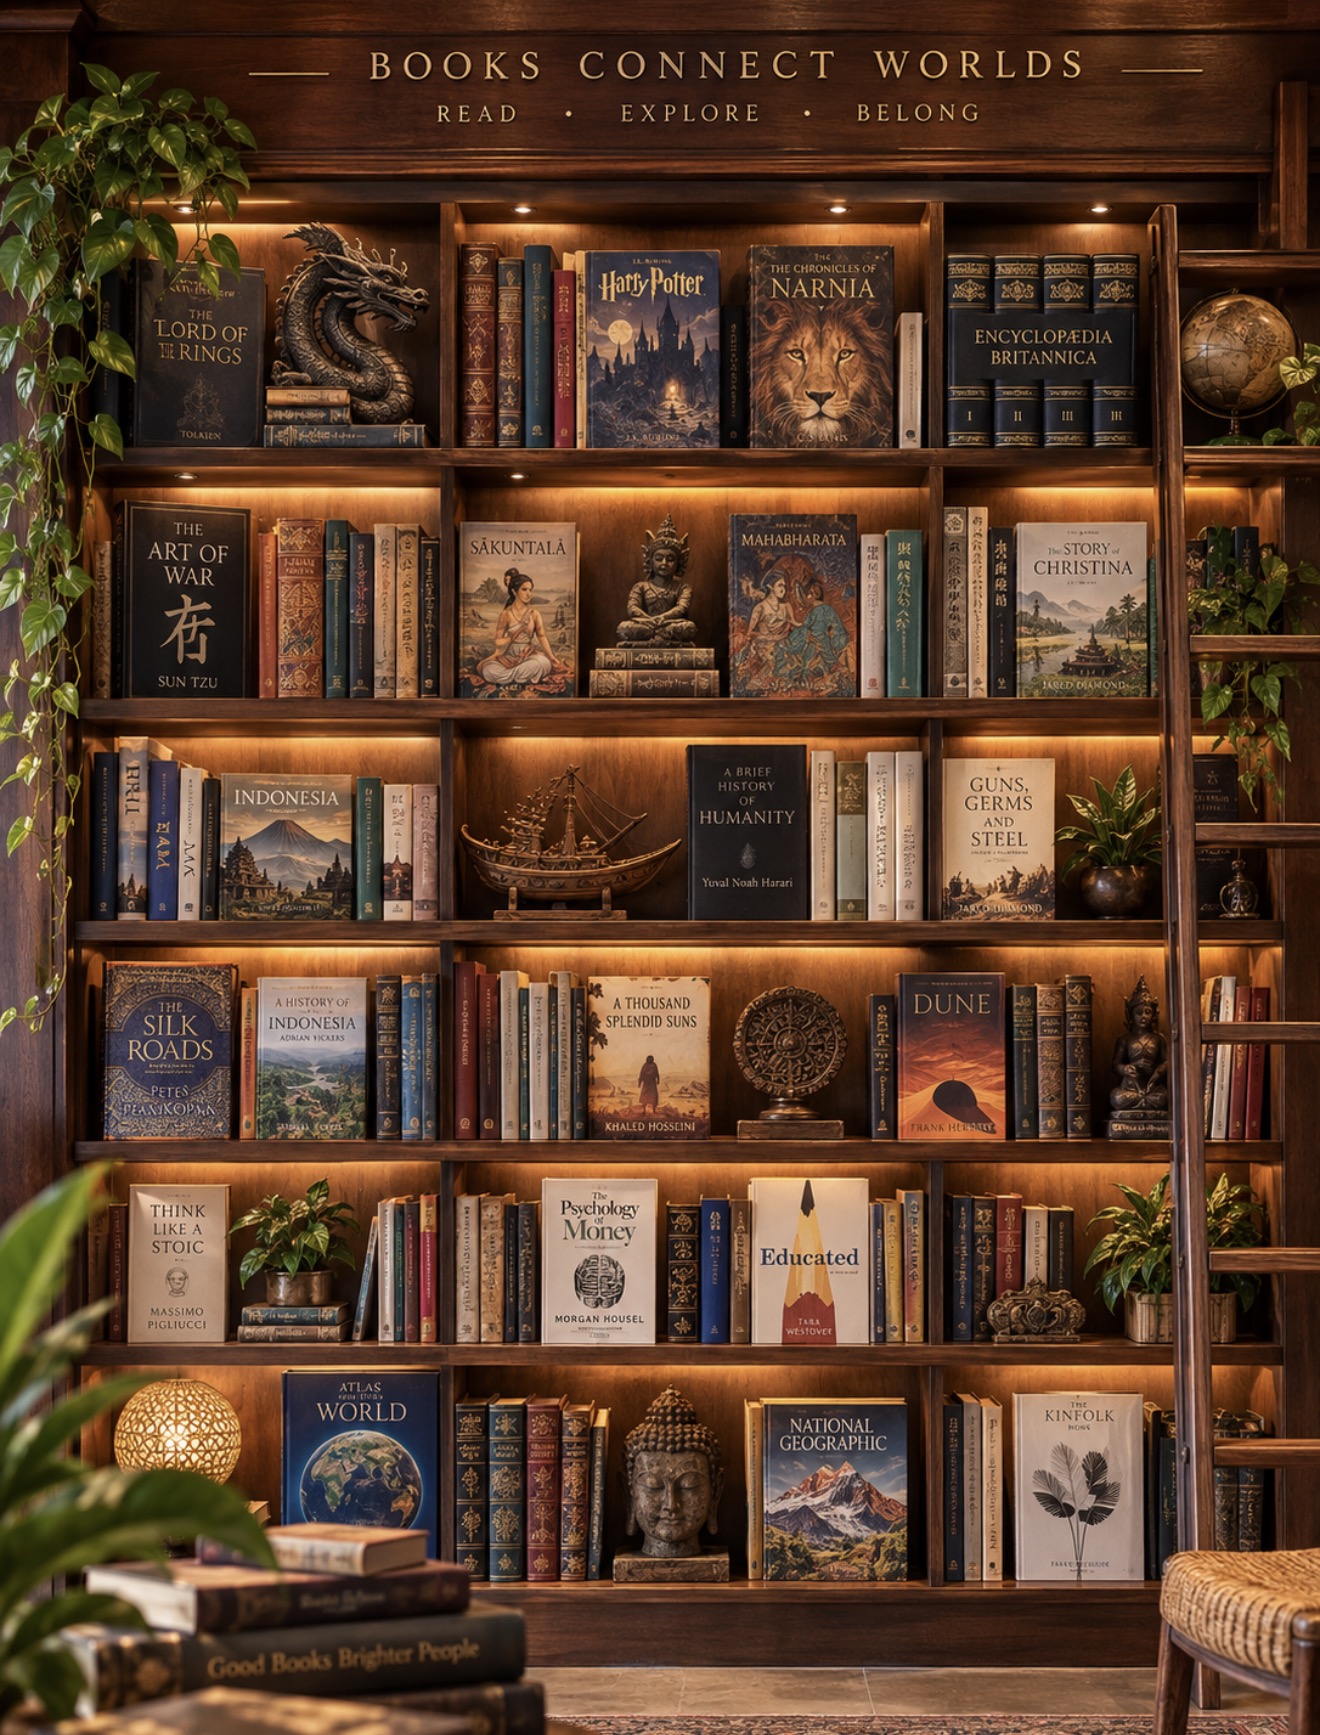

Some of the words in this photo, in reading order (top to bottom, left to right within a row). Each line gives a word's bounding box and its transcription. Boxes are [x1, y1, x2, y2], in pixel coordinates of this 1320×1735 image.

[369, 50, 542, 81] BOOKS
[579, 49, 836, 81] CONNECT
[873, 49, 1084, 81] WORLDS
[436, 103, 518, 123] READ
[620, 103, 760, 123] EXPLORE
[857, 103, 981, 123] BELONG
[771, 264, 791, 273] THE
[793, 264, 860, 273] CHRONICLES
[862, 264, 877, 273] OF
[597, 269, 650, 303] Harry
[650, 266, 705, 307] Potter
[769, 277, 876, 299] NARNIA
[188, 308, 213, 321] THE
[153, 318, 217, 342] LORD
[221, 325, 249, 344] OF
[974, 328, 1114, 345] ENCYCLOPÆDIA
[178, 343, 243, 365] RINGS
[990, 350, 1098, 366] BRITANNICA
[1061, 410, 1074, 422] III
[173, 521, 204, 537] THE
[741, 533, 847, 547] MAHABHARATA
[147, 541, 193, 562] ART
[198, 543, 230, 565] OF
[1063, 542, 1111, 556] STORY
[1033, 559, 1133, 576] CHRISTINA
[163, 564, 216, 587] WAR
[157, 675, 188, 689] SUN
[190, 676, 219, 689] TZU
[723, 768, 732, 778] A
[736, 766, 773, 778] BRIEF
[717, 781, 776, 792] HISTORY
[969, 776, 1029, 794] GUNS,
[234, 788, 340, 807] INDONESIA
[738, 796, 756, 807] OF
[964, 795, 1034, 811] GERMS
[699, 810, 796, 825] HUMANITY
[983, 817, 1015, 828] AND
[970, 830, 1029, 847] STEEL
[702, 877, 730, 888] Yuval
[732, 877, 759, 888] Noah
[761, 876, 794, 888] Harari
[157, 1001, 184, 1014] THE
[275, 998, 283, 1008] A
[285, 997, 334, 1008] HISTORY
[336, 997, 351, 1007] OF
[613, 998, 622, 1010] A
[624, 997, 691, 1010] THOUSAND
[913, 993, 992, 1015] DUNE
[143, 1014, 200, 1037] SILK
[268, 1016, 357, 1030] INDONESIA
[605, 1014, 663, 1029] SPLENDID
[666, 1014, 698, 1029] SUNS
[279, 1033, 311, 1042] ADRIAN
[127, 1039, 214, 1062] ROADS
[604, 1121, 645, 1132] KHALED
[591, 1191, 608, 1201] The
[150, 1204, 206, 1218] THINK
[560, 1199, 640, 1221] Psychology
[594, 1216, 605, 1225] of
[153, 1222, 187, 1236] LIKE
[192, 1224, 202, 1236] A
[562, 1218, 637, 1247] Money
[151, 1240, 205, 1255] STOIC
[759, 1247, 860, 1266] Educated
[150, 1307, 205, 1317] MASSIMO
[554, 1314, 600, 1324] MORGAN
[603, 1314, 645, 1324] HOUSEL
[147, 1319, 207, 1330] PIGLIUCCI
[338, 1381, 383, 1393] ATLAS
[316, 1401, 408, 1423] WORLD
[1045, 1409, 1115, 1422] KINFOLK
[789, 1417, 874, 1434] NATIONAL
[779, 1434, 888, 1452] GEOGRAPHIC
[206, 1653, 267, 1680] Good
[270, 1648, 333, 1675] Books
[337, 1643, 414, 1673] Brighter
[417, 1637, 481, 1665] People
